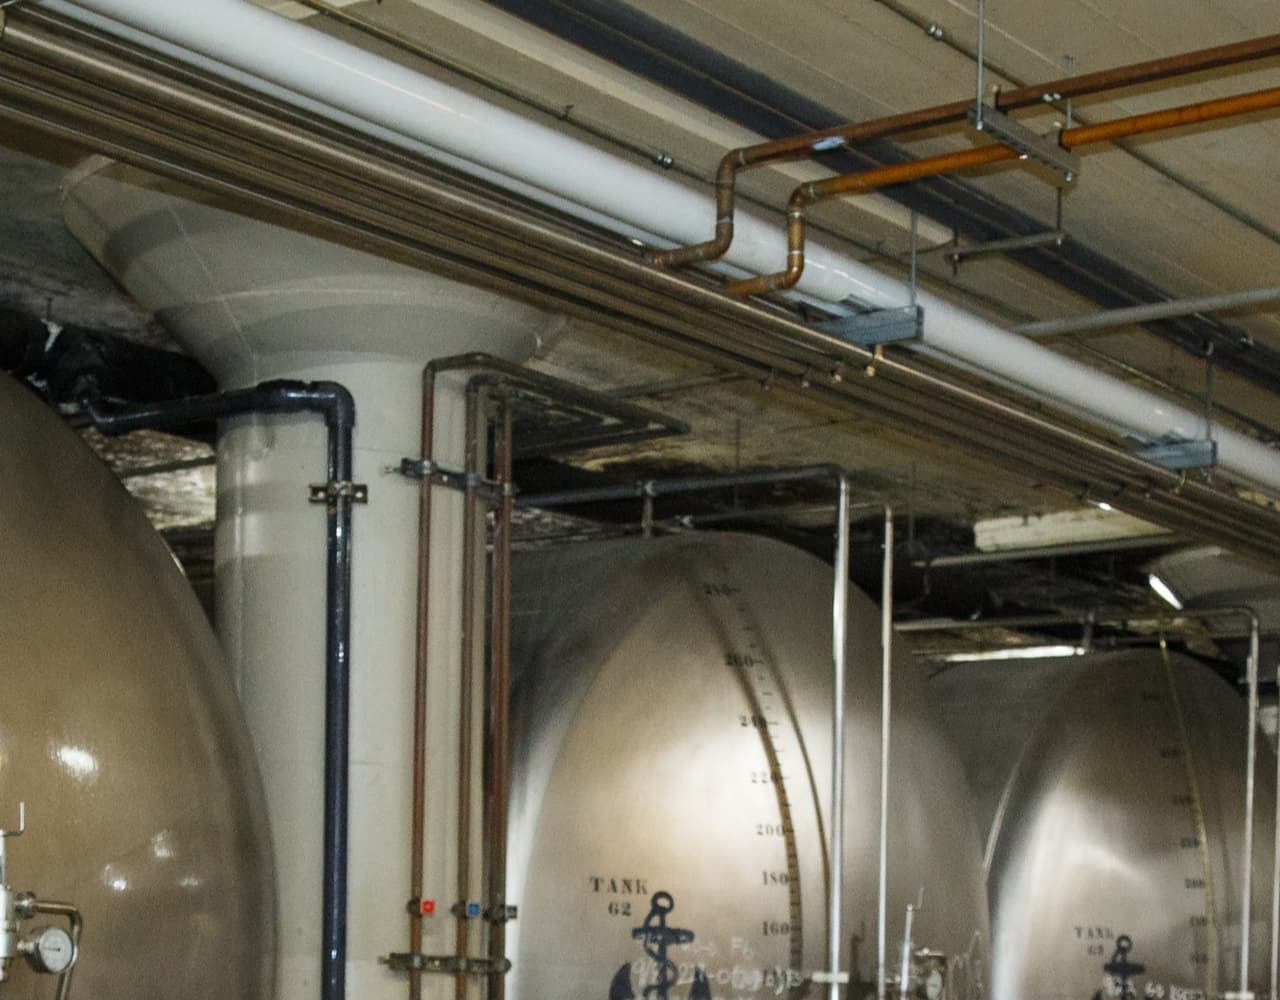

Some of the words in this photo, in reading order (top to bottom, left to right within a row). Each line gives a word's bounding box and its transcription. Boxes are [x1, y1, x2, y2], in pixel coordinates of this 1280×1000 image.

[590, 876, 648, 895] TANK
[762, 871, 790, 886] 180
[607, 902, 632, 917] 62
[762, 921, 791, 937] 160
